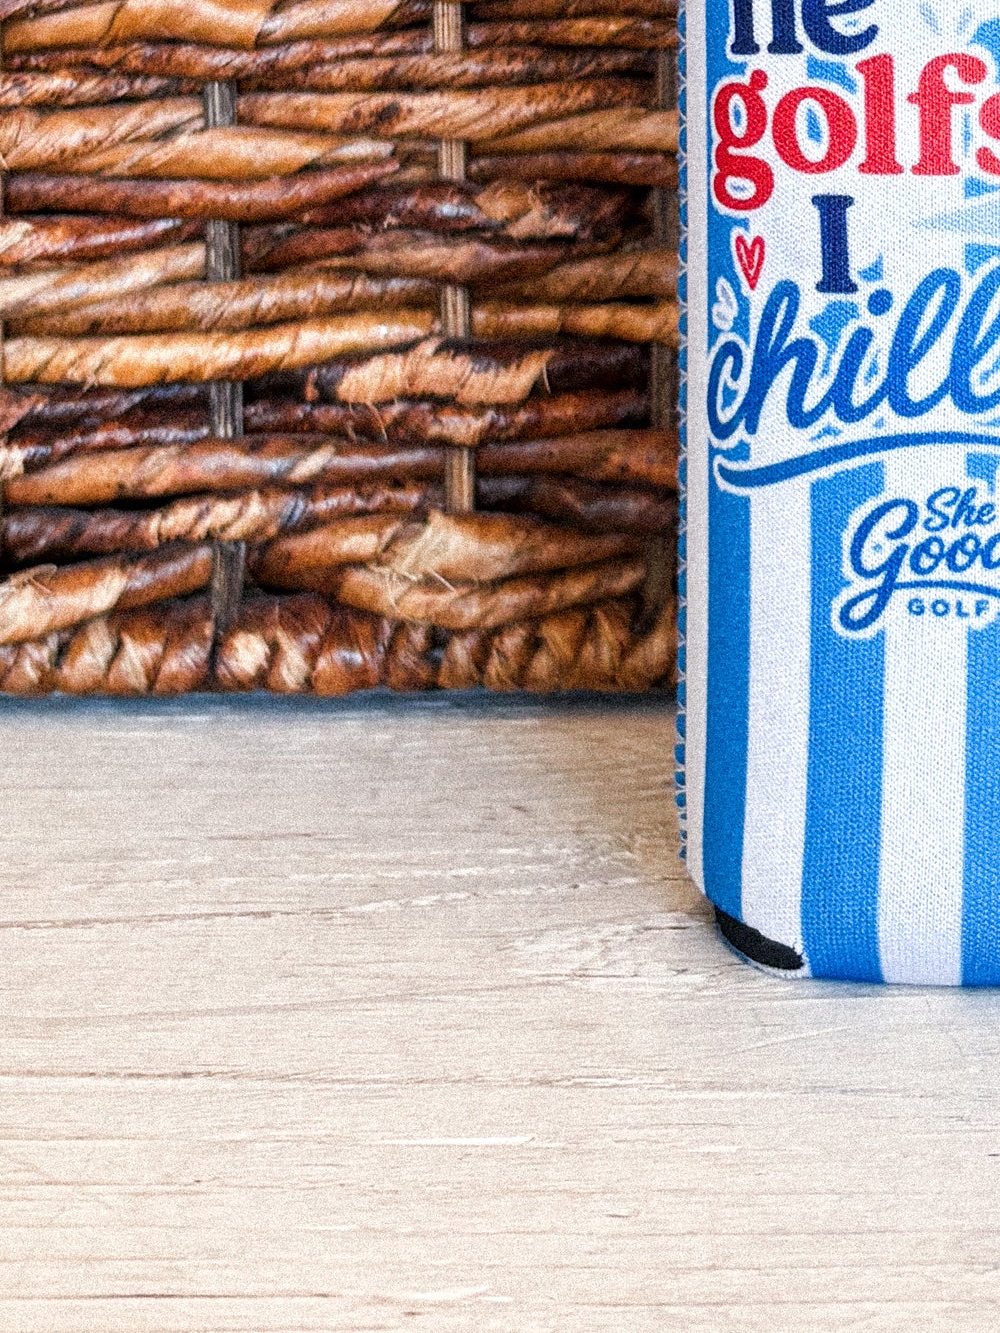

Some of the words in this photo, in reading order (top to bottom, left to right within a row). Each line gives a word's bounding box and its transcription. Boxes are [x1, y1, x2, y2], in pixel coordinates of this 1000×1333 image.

[812, 194, 858, 294] I
[923, 486, 996, 533] She
[907, 597, 989, 618] GOLF
